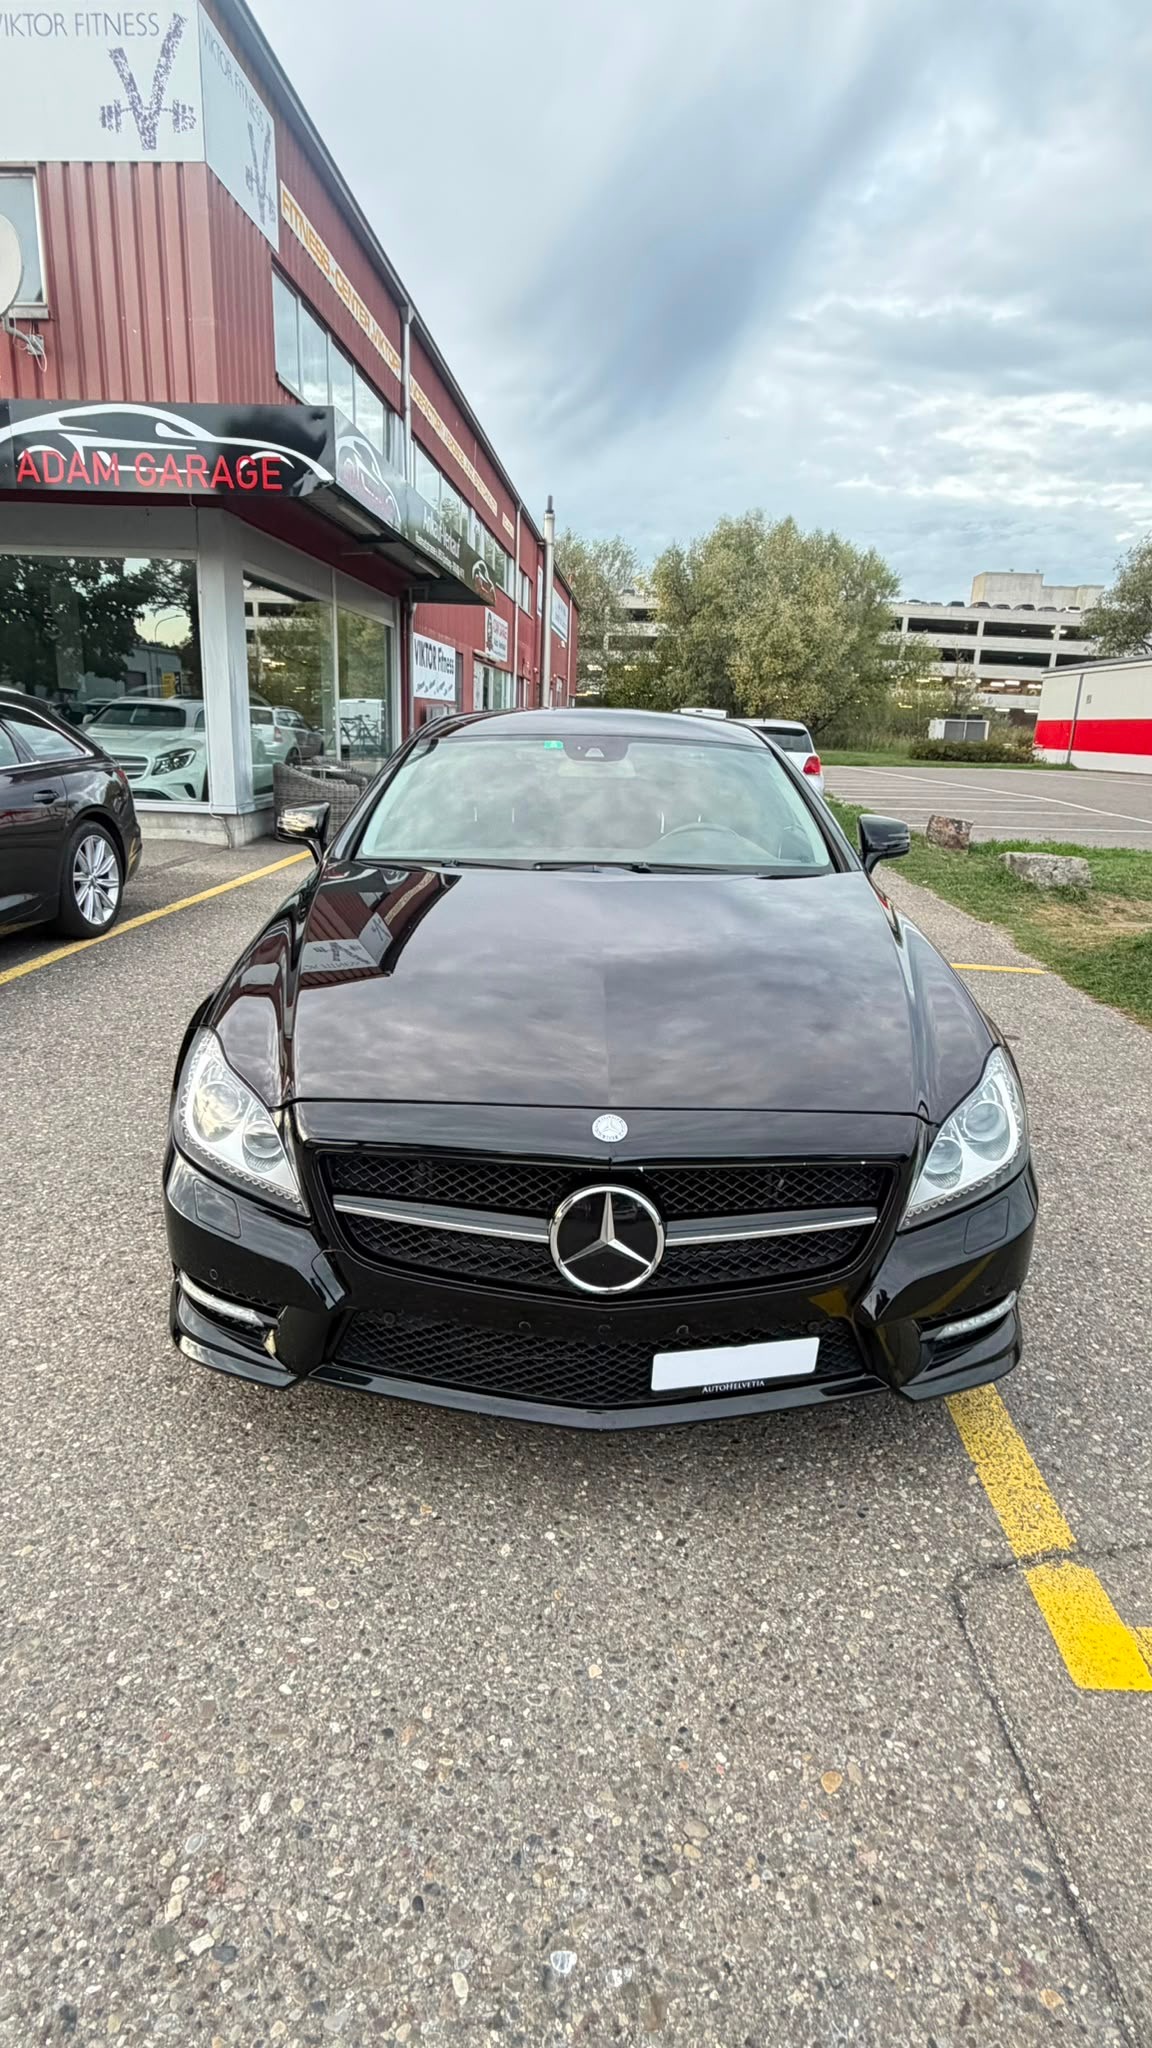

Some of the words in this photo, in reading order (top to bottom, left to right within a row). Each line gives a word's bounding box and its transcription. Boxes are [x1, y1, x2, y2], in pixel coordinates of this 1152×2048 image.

[0, 12, 68, 37] IKTOR
[74, 12, 160, 37] FITNESS
[16, 448, 121, 487] ADAM
[134, 451, 283, 490] GARAGE
[702, 1380, 765, 1394] AUTOHELVETIA
